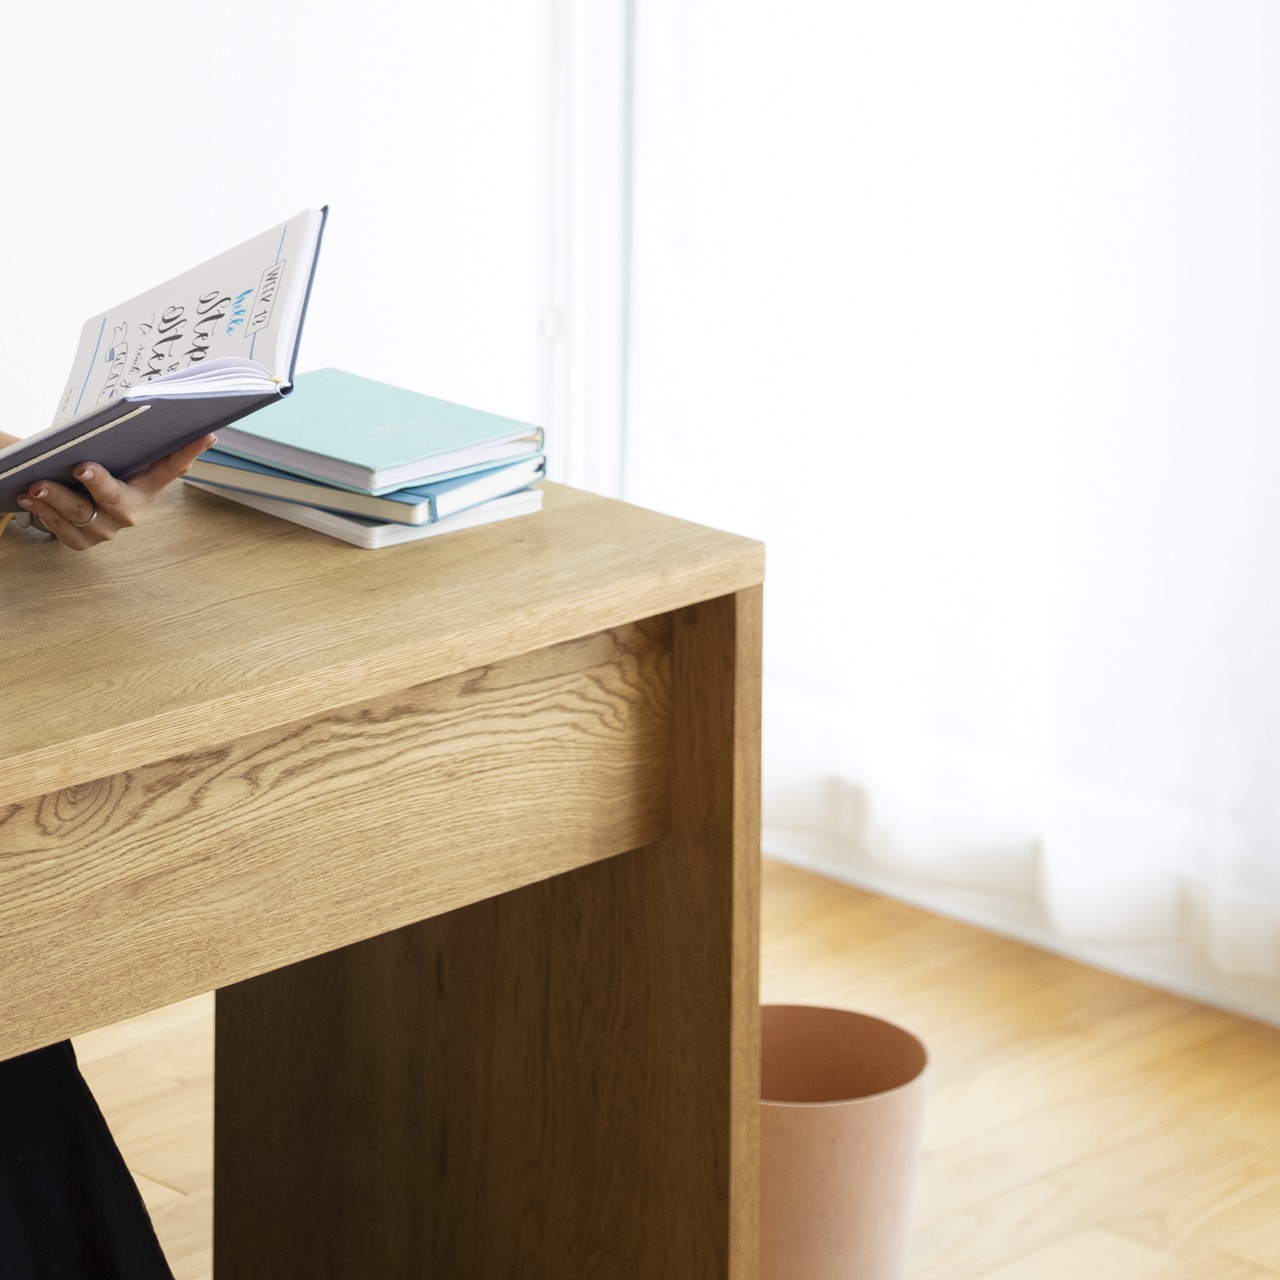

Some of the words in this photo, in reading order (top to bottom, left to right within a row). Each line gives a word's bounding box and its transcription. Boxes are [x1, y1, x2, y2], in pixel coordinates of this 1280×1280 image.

[258, 266, 281, 305] WEEK
[181, 291, 232, 367] Step
[225, 288, 254, 336] hello
